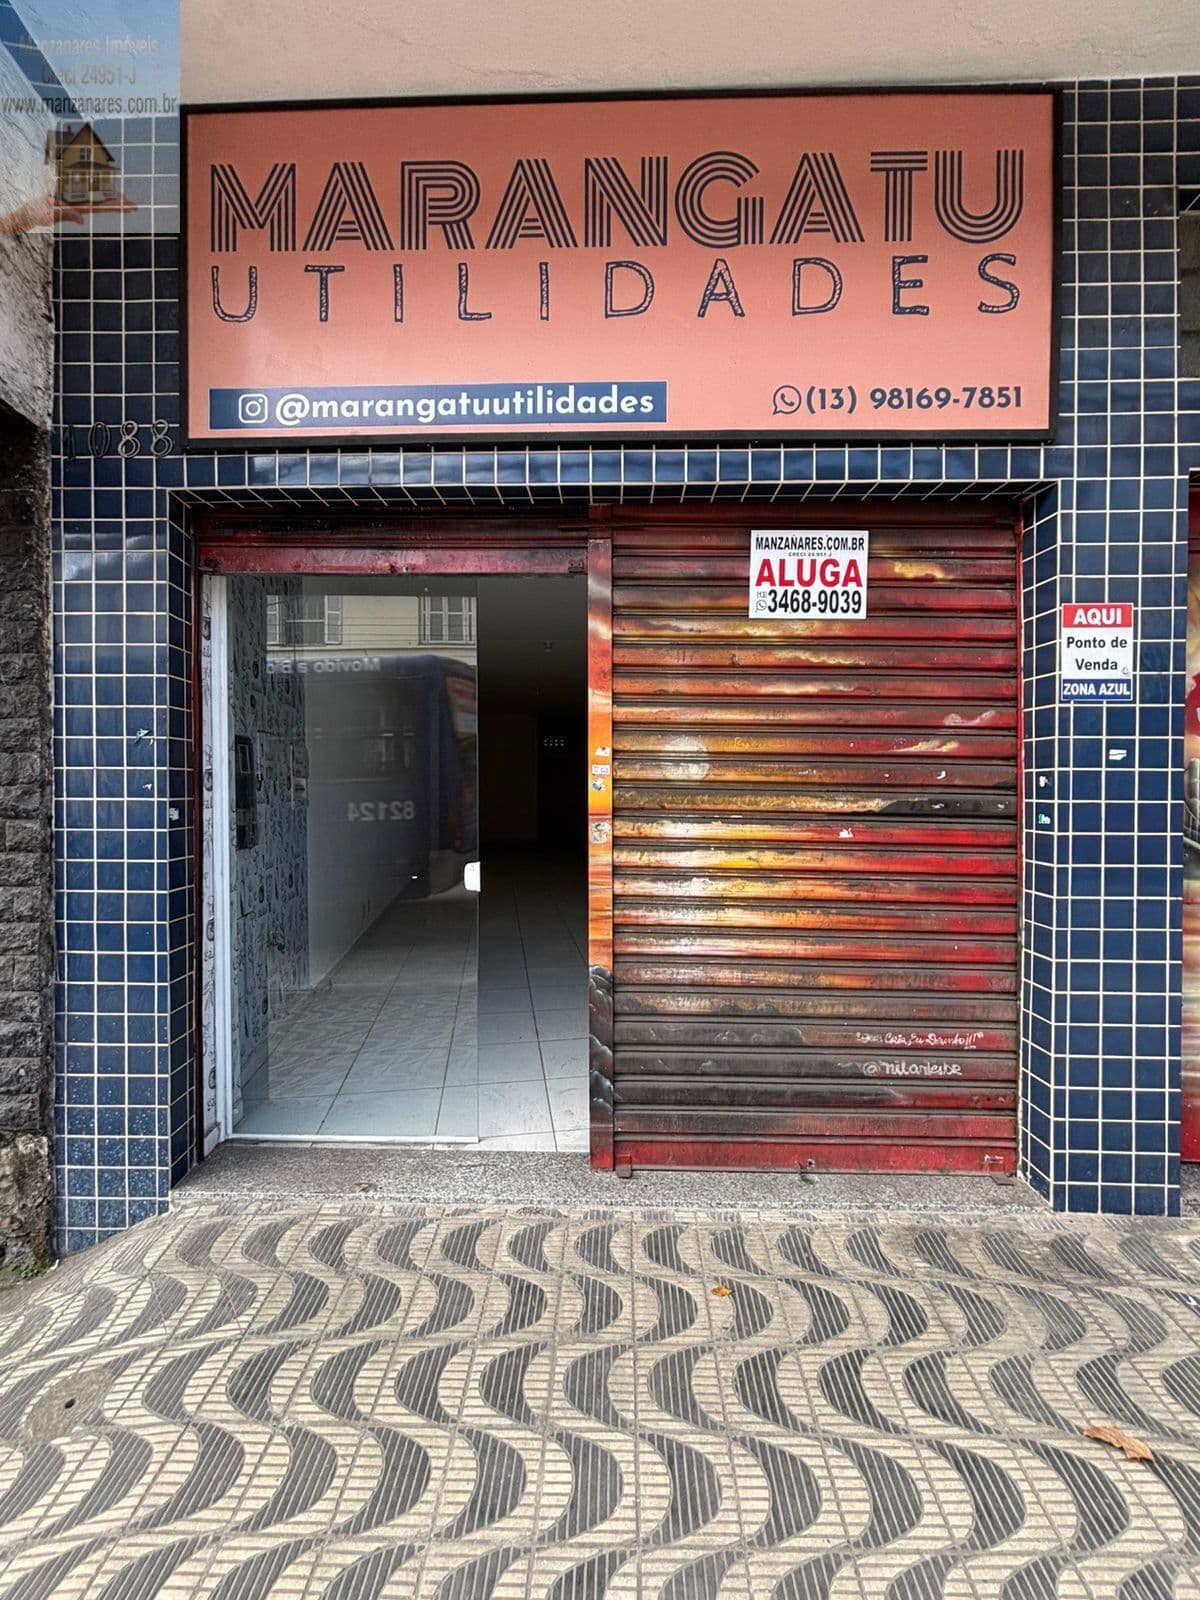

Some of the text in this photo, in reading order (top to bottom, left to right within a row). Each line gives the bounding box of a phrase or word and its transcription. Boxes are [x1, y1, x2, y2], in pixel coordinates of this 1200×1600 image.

[210, 149, 1024, 252] MARANGATU
[211, 253, 1021, 323] UTILIDADES
[275, 385, 654, 425] @marangatuutilidades
[806, 386, 1022, 415] (13) 98169-7851
[755, 536, 865, 551] MANZANARES.COM.BR
[755, 558, 863, 588] ALUGA
[767, 589, 862, 614] 3468-9039
[1073, 607, 1122, 626] AQUI
[1066, 636, 1128, 649] Ponto de
[1075, 658, 1118, 671] Venda
[1063, 682, 1131, 696] ZONA AZUL
